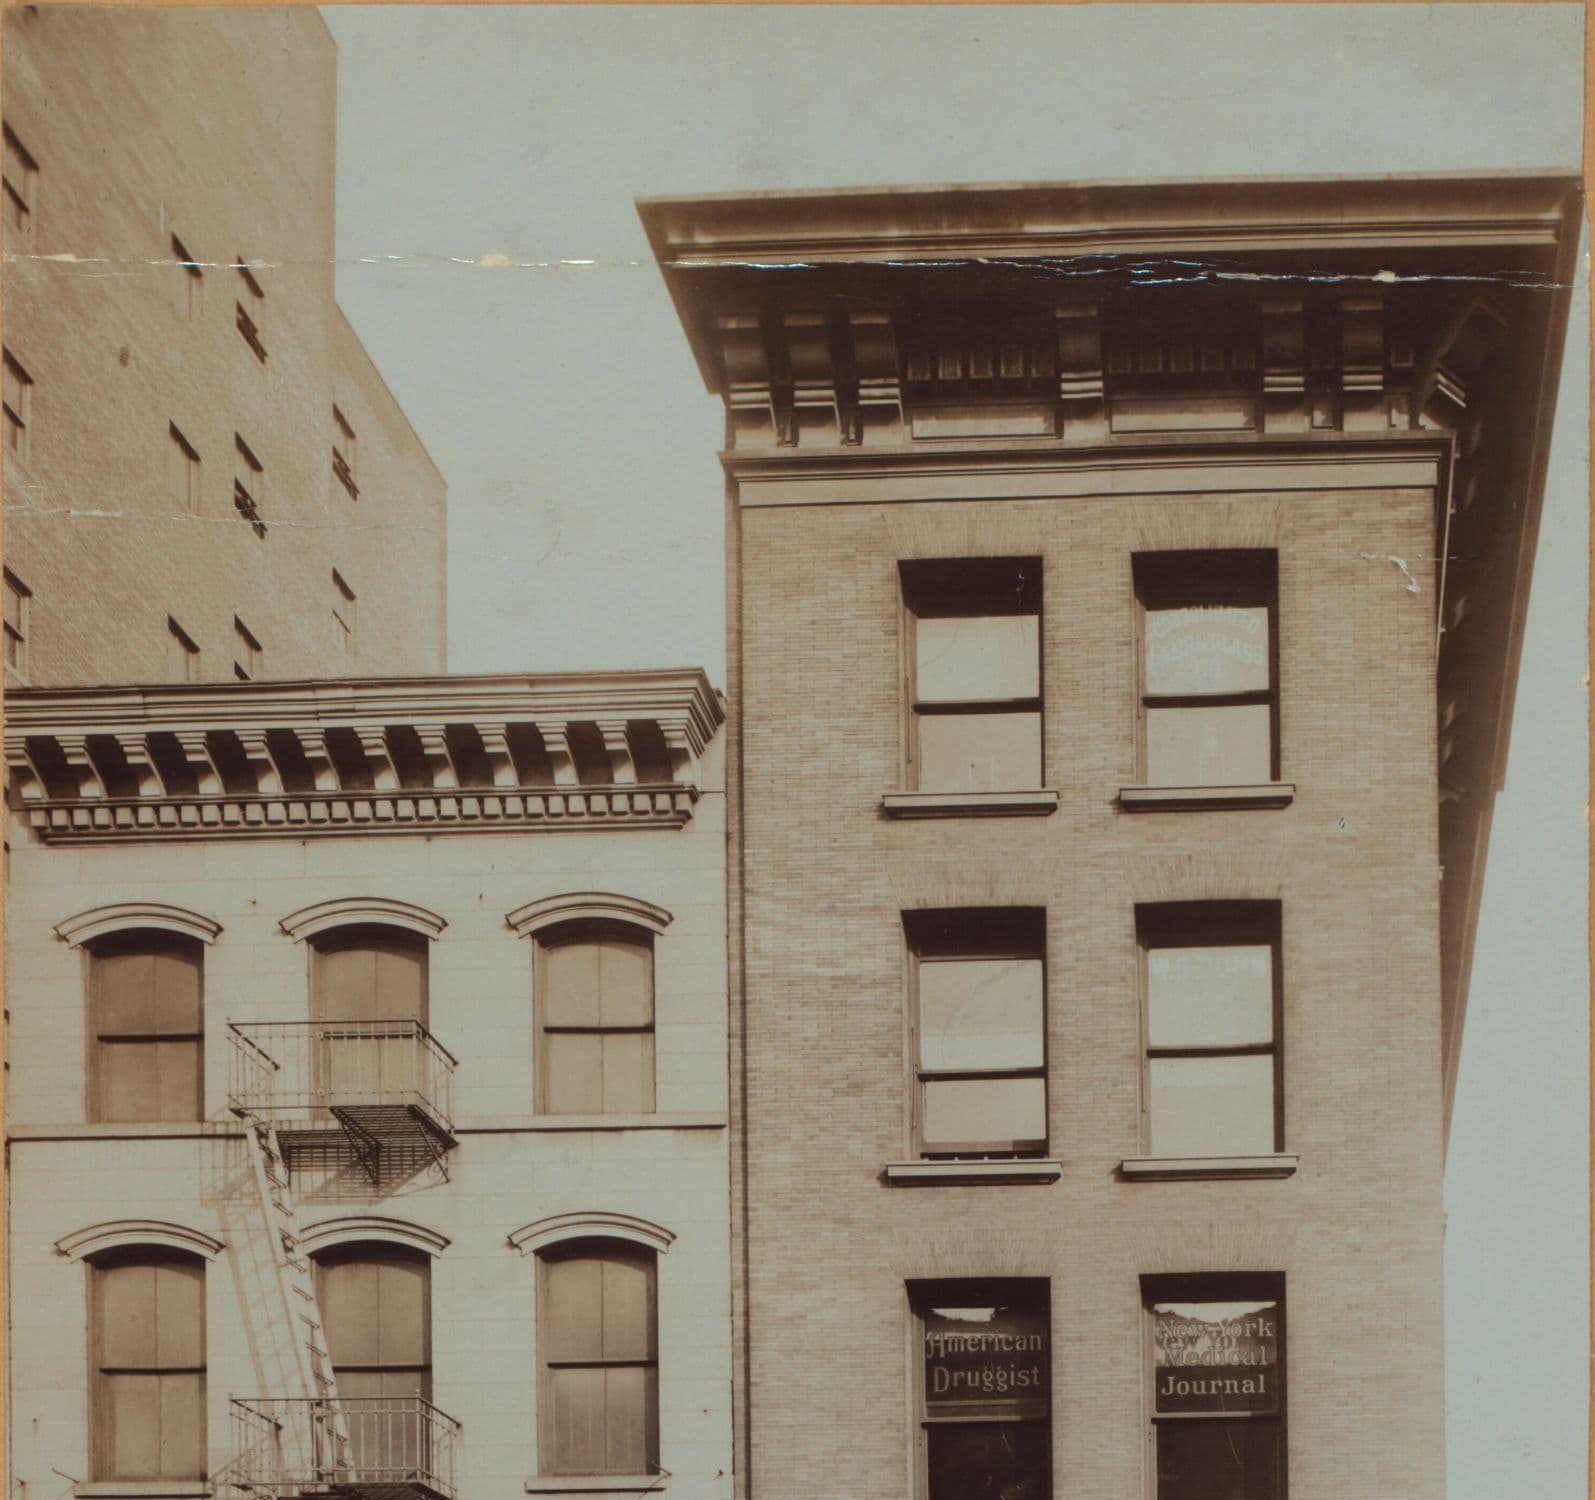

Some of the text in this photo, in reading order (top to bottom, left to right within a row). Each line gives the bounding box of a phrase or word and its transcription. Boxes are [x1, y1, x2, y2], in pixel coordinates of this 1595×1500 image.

[926, 1329, 1042, 1358] American
[1165, 1346, 1268, 1366] Medical
[934, 1364, 1040, 1392] Druggist
[1161, 1374, 1266, 1396] Journal
